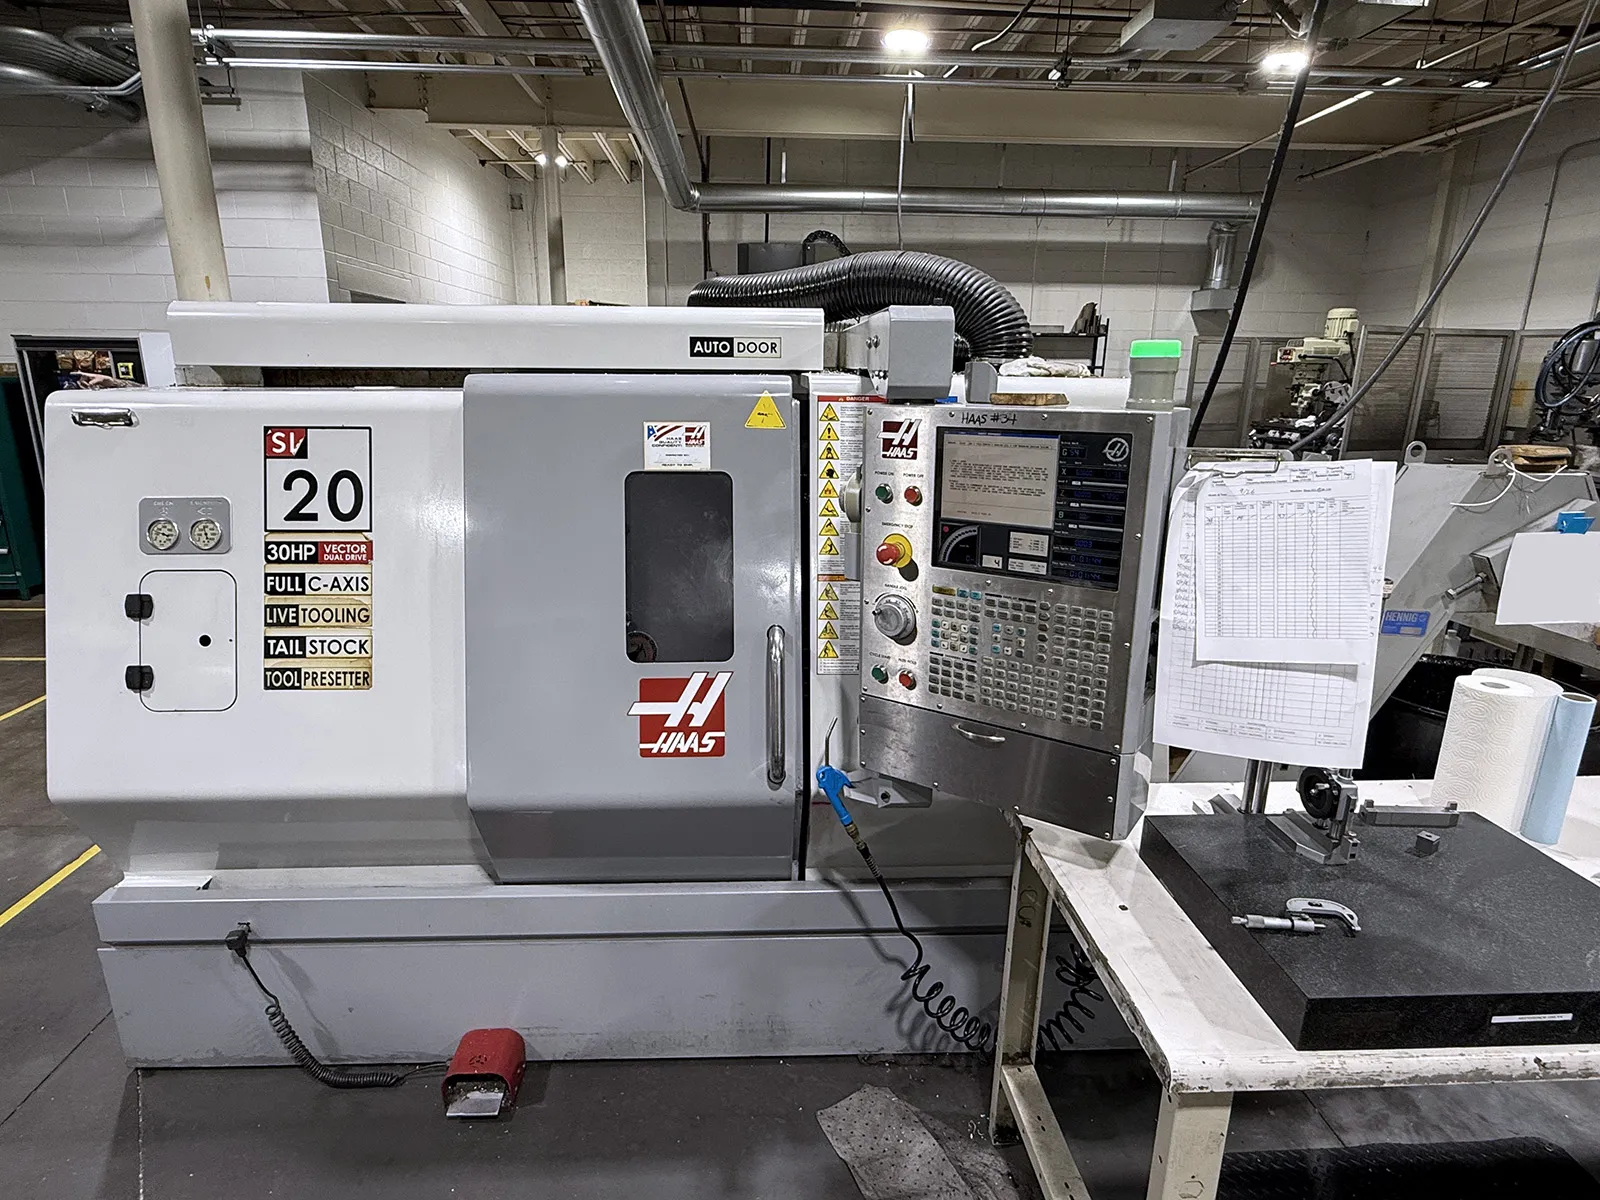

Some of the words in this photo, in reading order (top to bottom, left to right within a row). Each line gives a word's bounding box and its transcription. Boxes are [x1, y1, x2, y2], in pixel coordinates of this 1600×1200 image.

[693, 341, 730, 353] AUTO
[737, 341, 778, 354] DOOR
[961, 412, 988, 426] HAAS
[990, 412, 1017, 425] #34
[882, 446, 918, 459] HAAS
[1061, 448, 1068, 456] G
[1061, 467, 1067, 476] X
[283, 469, 364, 523] 20
[266, 543, 317, 561] 30HP
[323, 544, 367, 554] VECTOR
[323, 553, 345, 562] DUAL
[344, 553, 368, 562] DRIVE
[266, 576, 303, 592] FULL
[308, 576, 370, 593] C-AXIS
[266, 607, 297, 623] LIVE
[300, 607, 371, 623] TOOLING
[1384, 611, 1418, 623] HENNIG
[267, 639, 304, 655] TAIL
[308, 639, 369, 655] STOCK
[266, 671, 300, 686] TOOL
[303, 671, 370, 686] PRESETTER
[639, 731, 726, 754] HAAS
